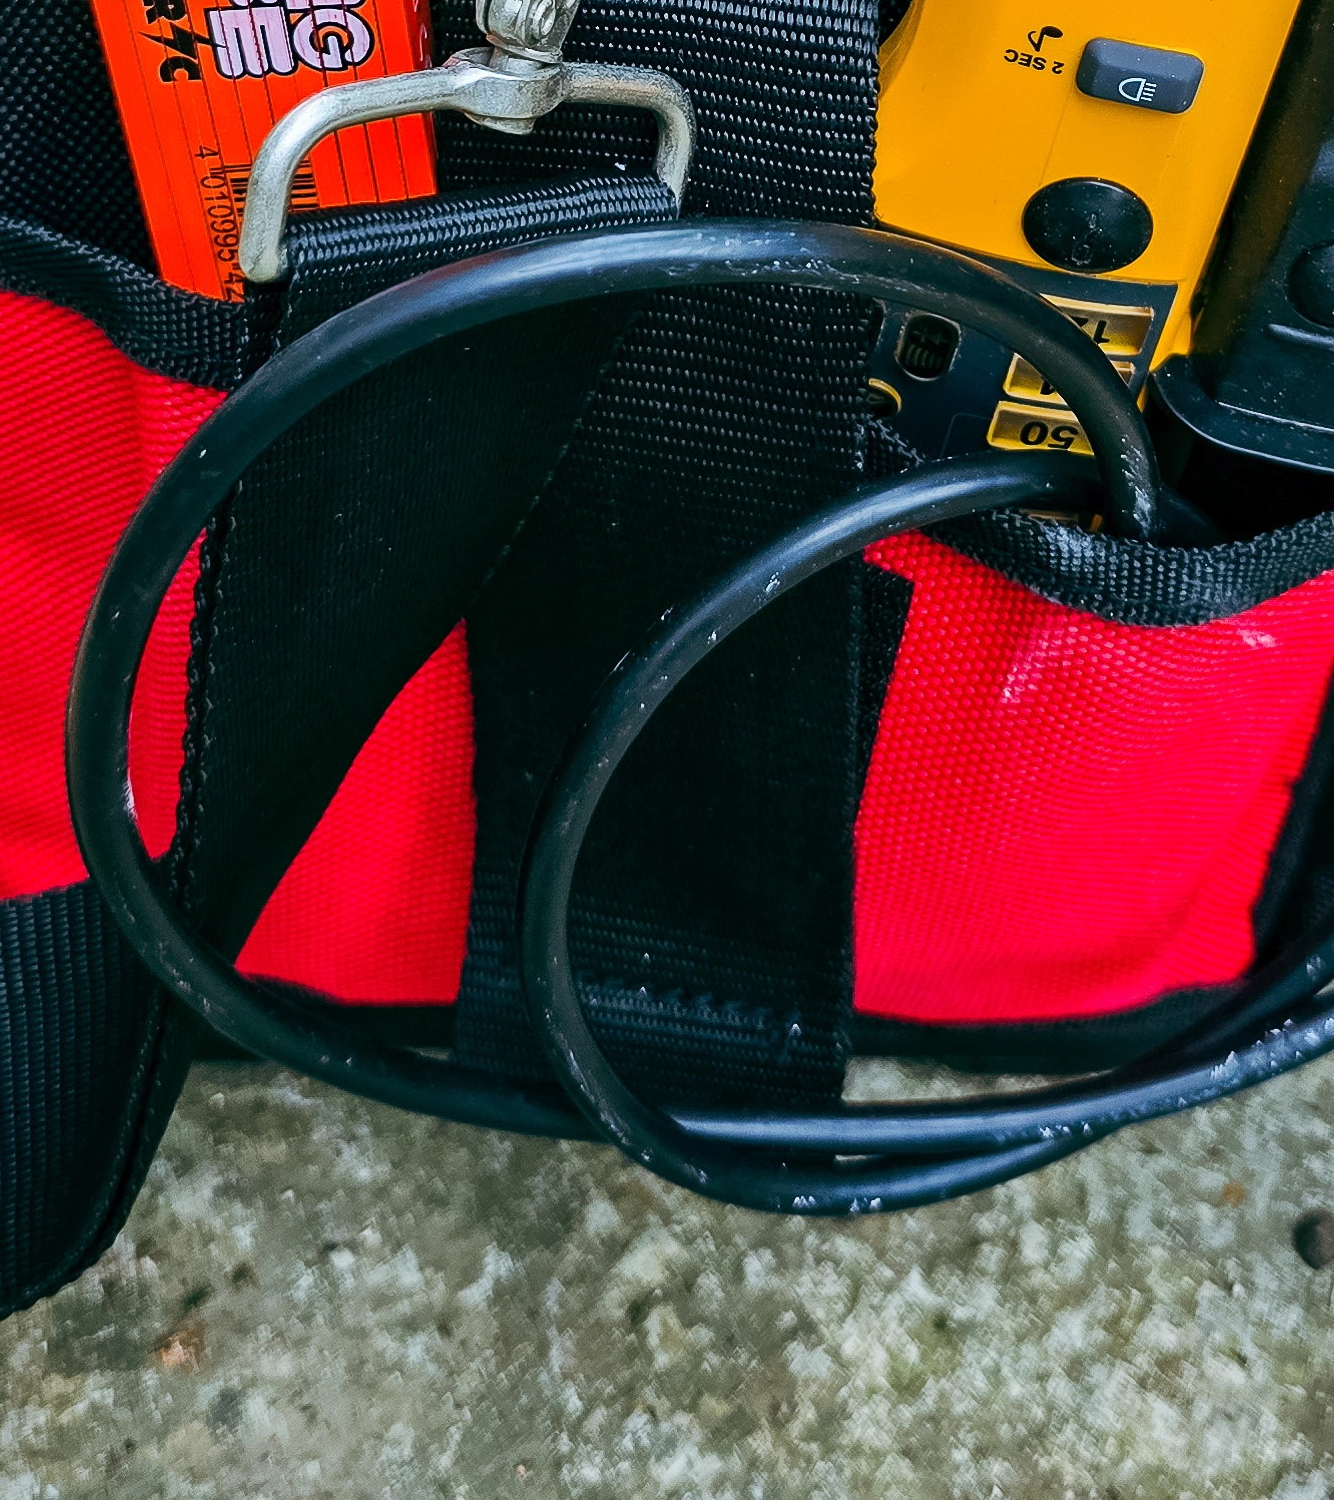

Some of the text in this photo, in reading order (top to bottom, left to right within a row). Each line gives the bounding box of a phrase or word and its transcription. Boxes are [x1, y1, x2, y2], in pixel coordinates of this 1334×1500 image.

[1003, 48, 1065, 75] 2 SEC
[1019, 420, 1079, 449] 50
